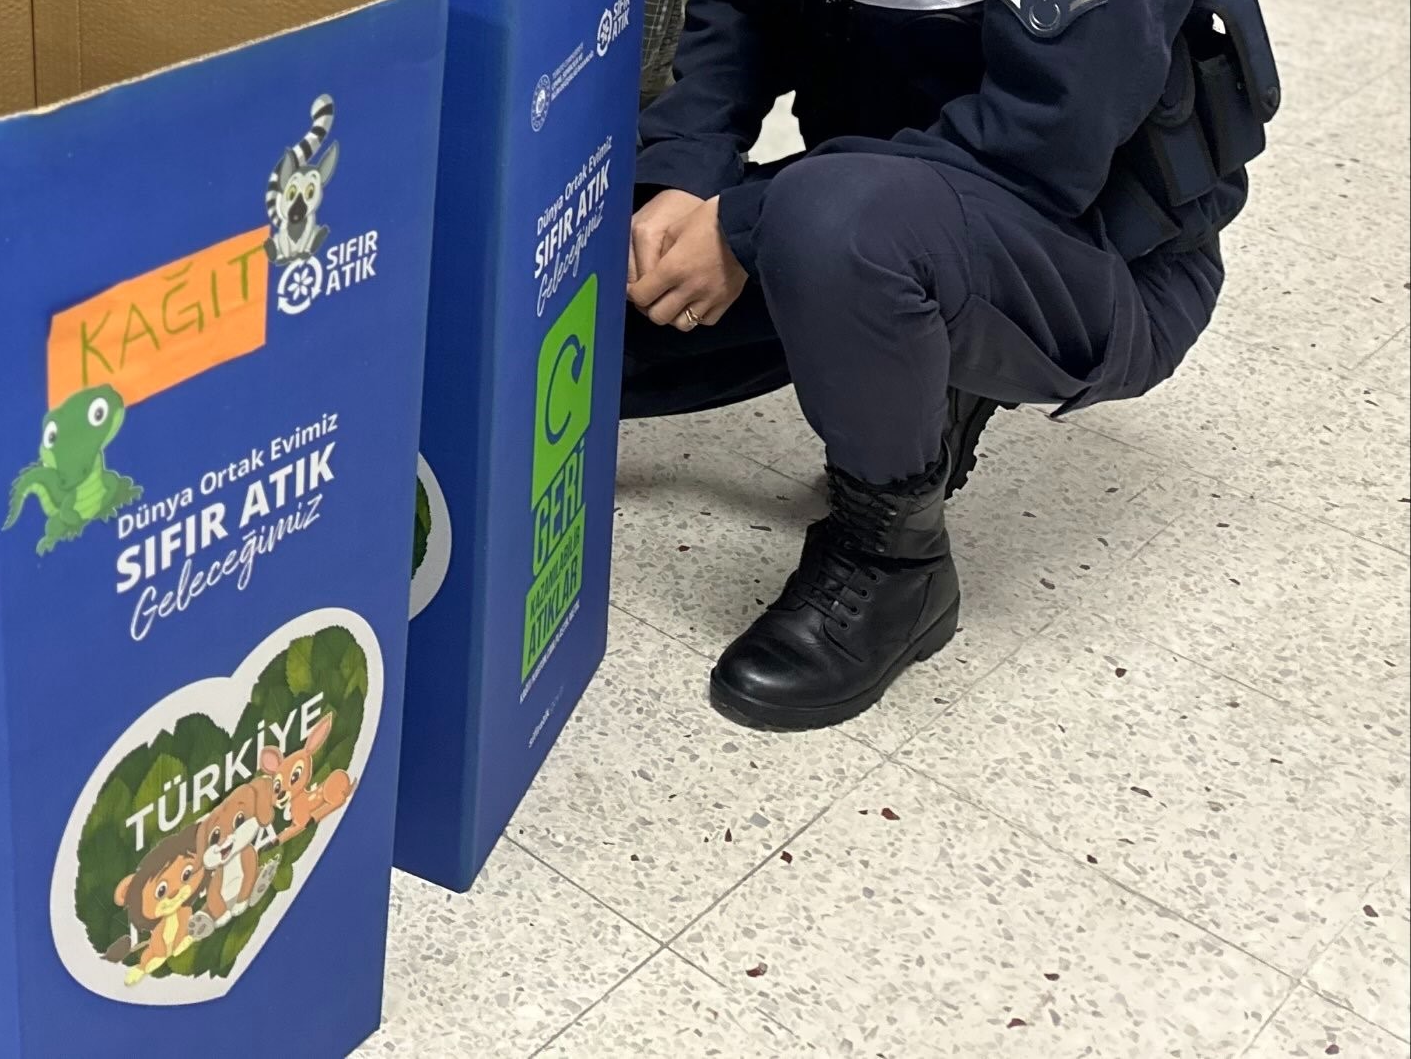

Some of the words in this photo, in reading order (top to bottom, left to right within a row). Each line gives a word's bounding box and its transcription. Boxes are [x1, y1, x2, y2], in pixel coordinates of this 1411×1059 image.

[534, 207, 573, 279] SIFIR
[576, 159, 610, 228] ATIK
[537, 195, 563, 236] Dünya
[565, 164, 587, 202] Ortak
[589, 136, 612, 171] Evimiz
[326, 230, 378, 270] SIFIR
[326, 253, 376, 295] ATIK
[81, 244, 265, 387] KAĞIT
[116, 502, 229, 593] SIFIR
[239, 441, 336, 529] ATIK
[118, 487, 193, 539] Dünya
[200, 449, 264, 495] Ortak
[270, 413, 338, 461] Evimiz
[533, 437, 584, 578] GERİ
[130, 493, 324, 641] Geleceğimiz
[527, 554, 578, 667] ATIKLAR
[125, 692, 324, 852] TÜRKİYE
